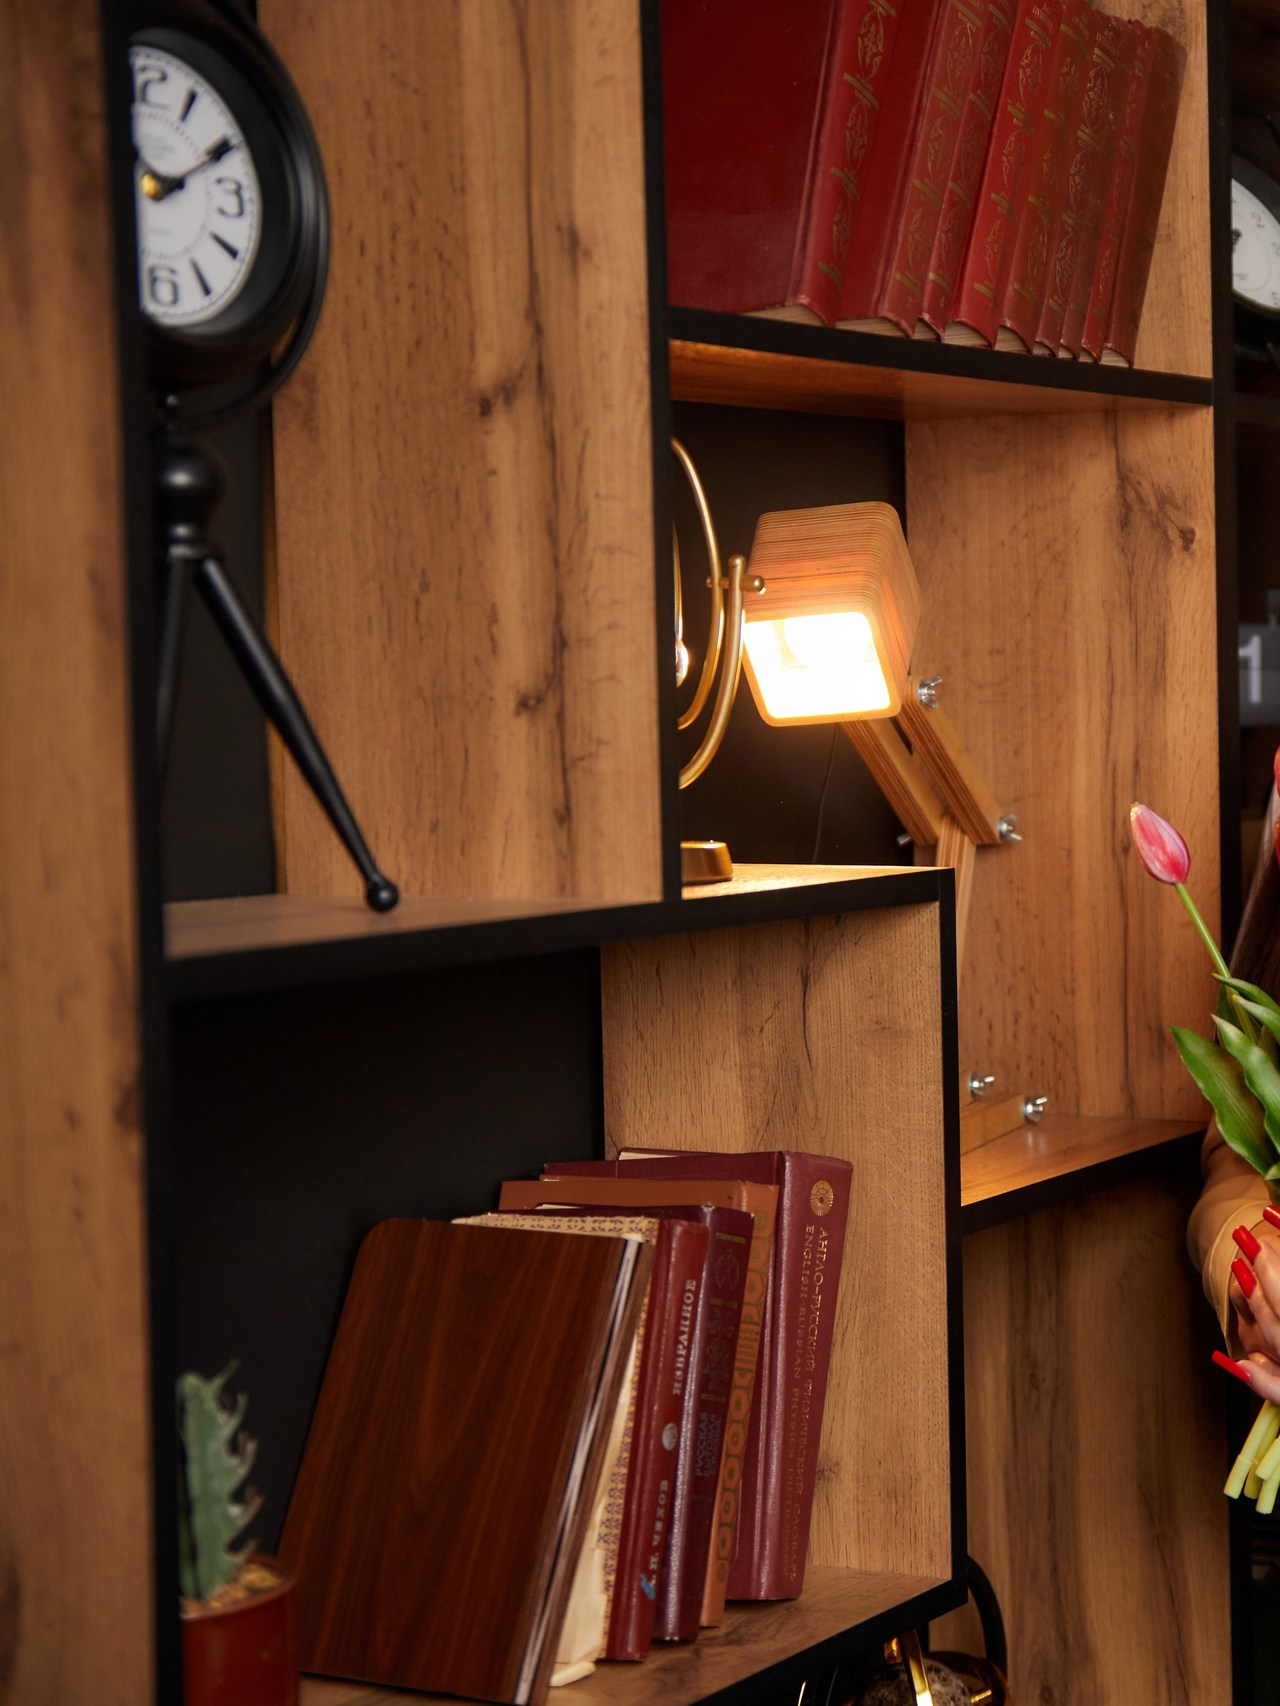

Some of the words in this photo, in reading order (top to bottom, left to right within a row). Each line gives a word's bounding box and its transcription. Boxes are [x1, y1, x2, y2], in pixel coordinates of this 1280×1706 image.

[215, 177, 244, 218] 3
[1251, 211, 1265, 229] 2
[149, 264, 179, 305] 6
[793, 1225, 815, 1378] ENGLISH-RUSSIAN
[805, 1227, 828, 1371] АНГЛО-РУССКИЙ
[673, 1280, 696, 1395] ИЗБРАННОЕ
[652, 1480, 669, 1547] ЧЕХОВ
